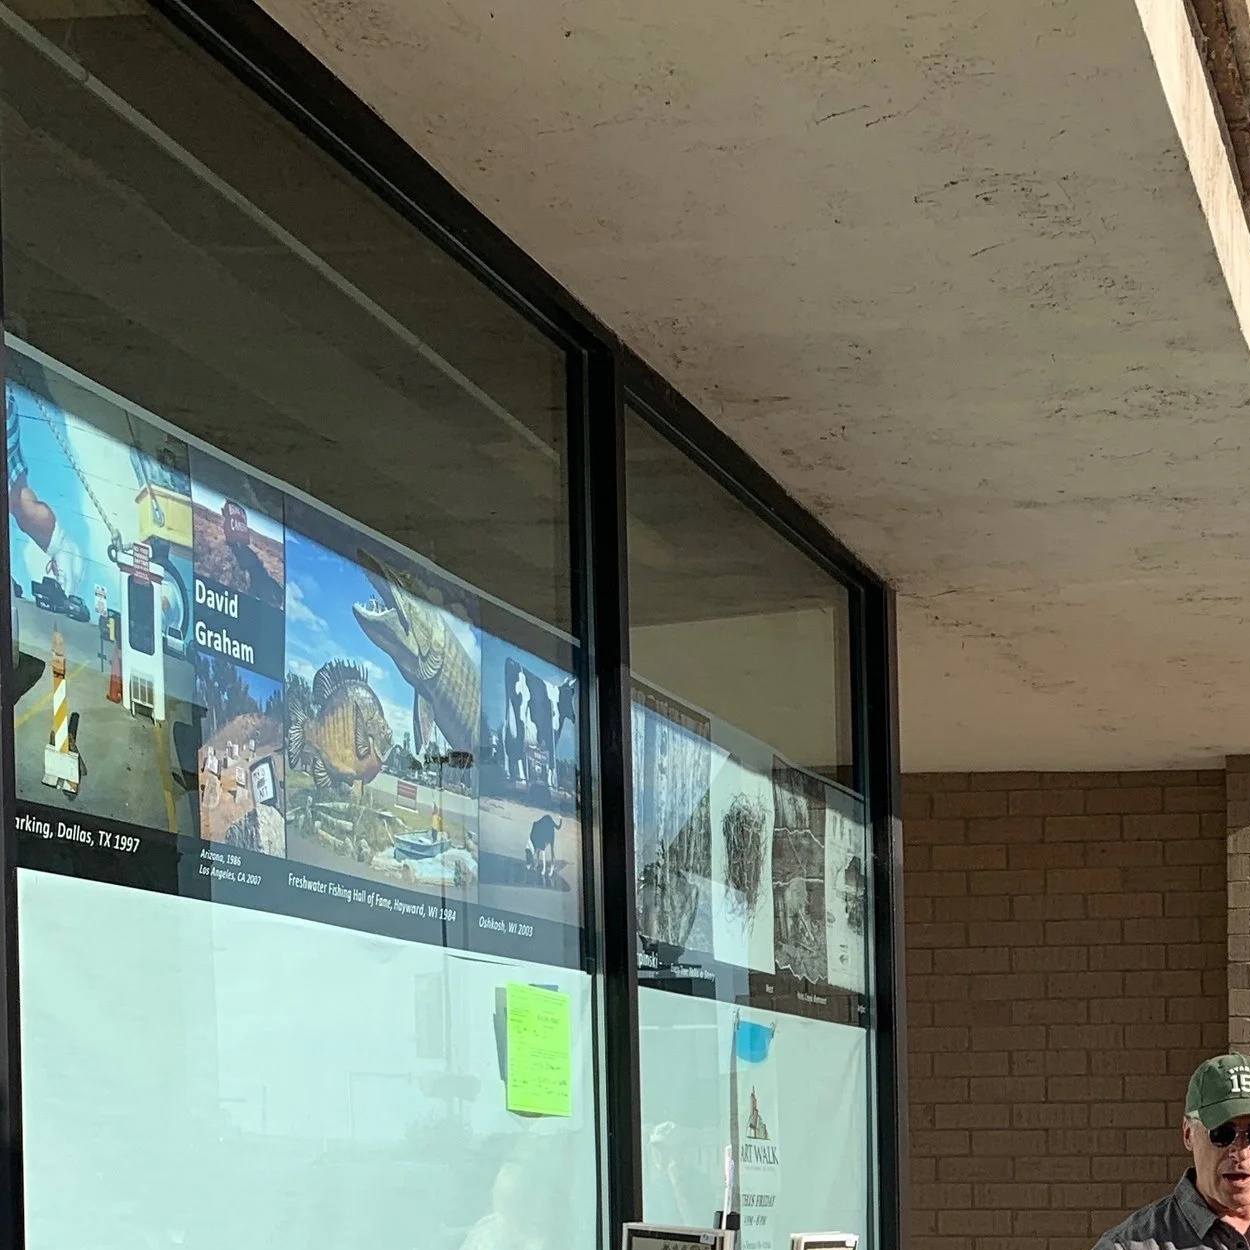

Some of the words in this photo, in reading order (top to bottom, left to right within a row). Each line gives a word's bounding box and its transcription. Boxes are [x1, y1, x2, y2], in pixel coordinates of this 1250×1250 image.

[195, 579, 239, 619] David
[195, 620, 255, 665] Graham
[57, 822, 94, 847] Dallas,
[98, 830, 112, 847] TX
[113, 834, 140, 853] 1997
[200, 848, 225, 864] Arizona,
[226, 854, 242, 866] 1986
[199, 864, 210, 875] Los
[210, 866, 236, 882] Angeles,
[237, 871, 246, 882] CA
[246, 873, 262, 886] 2007
[288, 872, 327, 894] Freshwater
[328, 882, 352, 903] Fishing
[352, 888, 367, 903] Hall
[367, 891, 376, 907] of
[376, 893, 393, 911] Fame,
[393, 898, 426, 918] Hayward,
[428, 905, 438, 918] WI
[439, 908, 457, 922] 1984
[479, 915, 506, 934] Oshkosh,
[508, 921, 518, 934] WI
[518, 923, 533, 937] 2003
[753, 1145, 779, 1165] WALK
